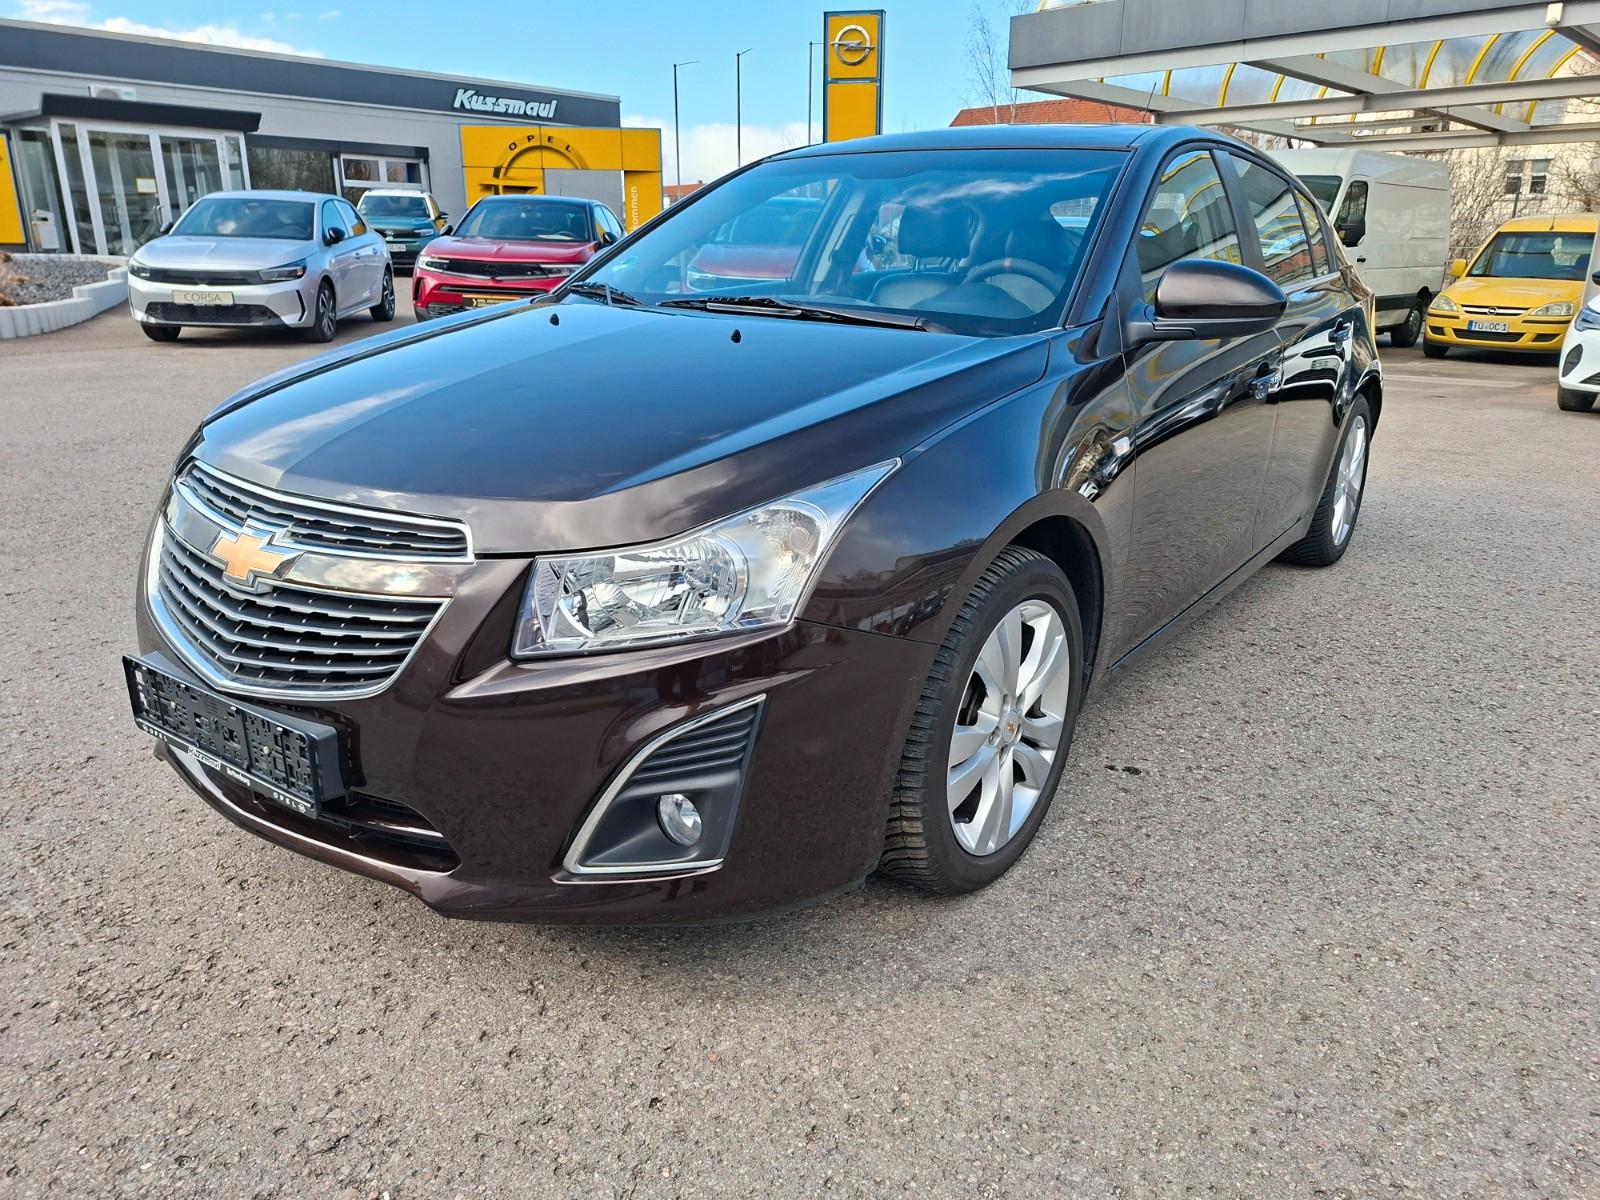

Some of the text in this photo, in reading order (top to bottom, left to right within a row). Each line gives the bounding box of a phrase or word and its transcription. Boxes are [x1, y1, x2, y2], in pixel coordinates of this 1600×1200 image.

[453, 88, 558, 119] Kussmaul
[508, 134, 573, 153] OPEL
[183, 291, 223, 303] CORSA
[273, 791, 298, 809] OPEL
